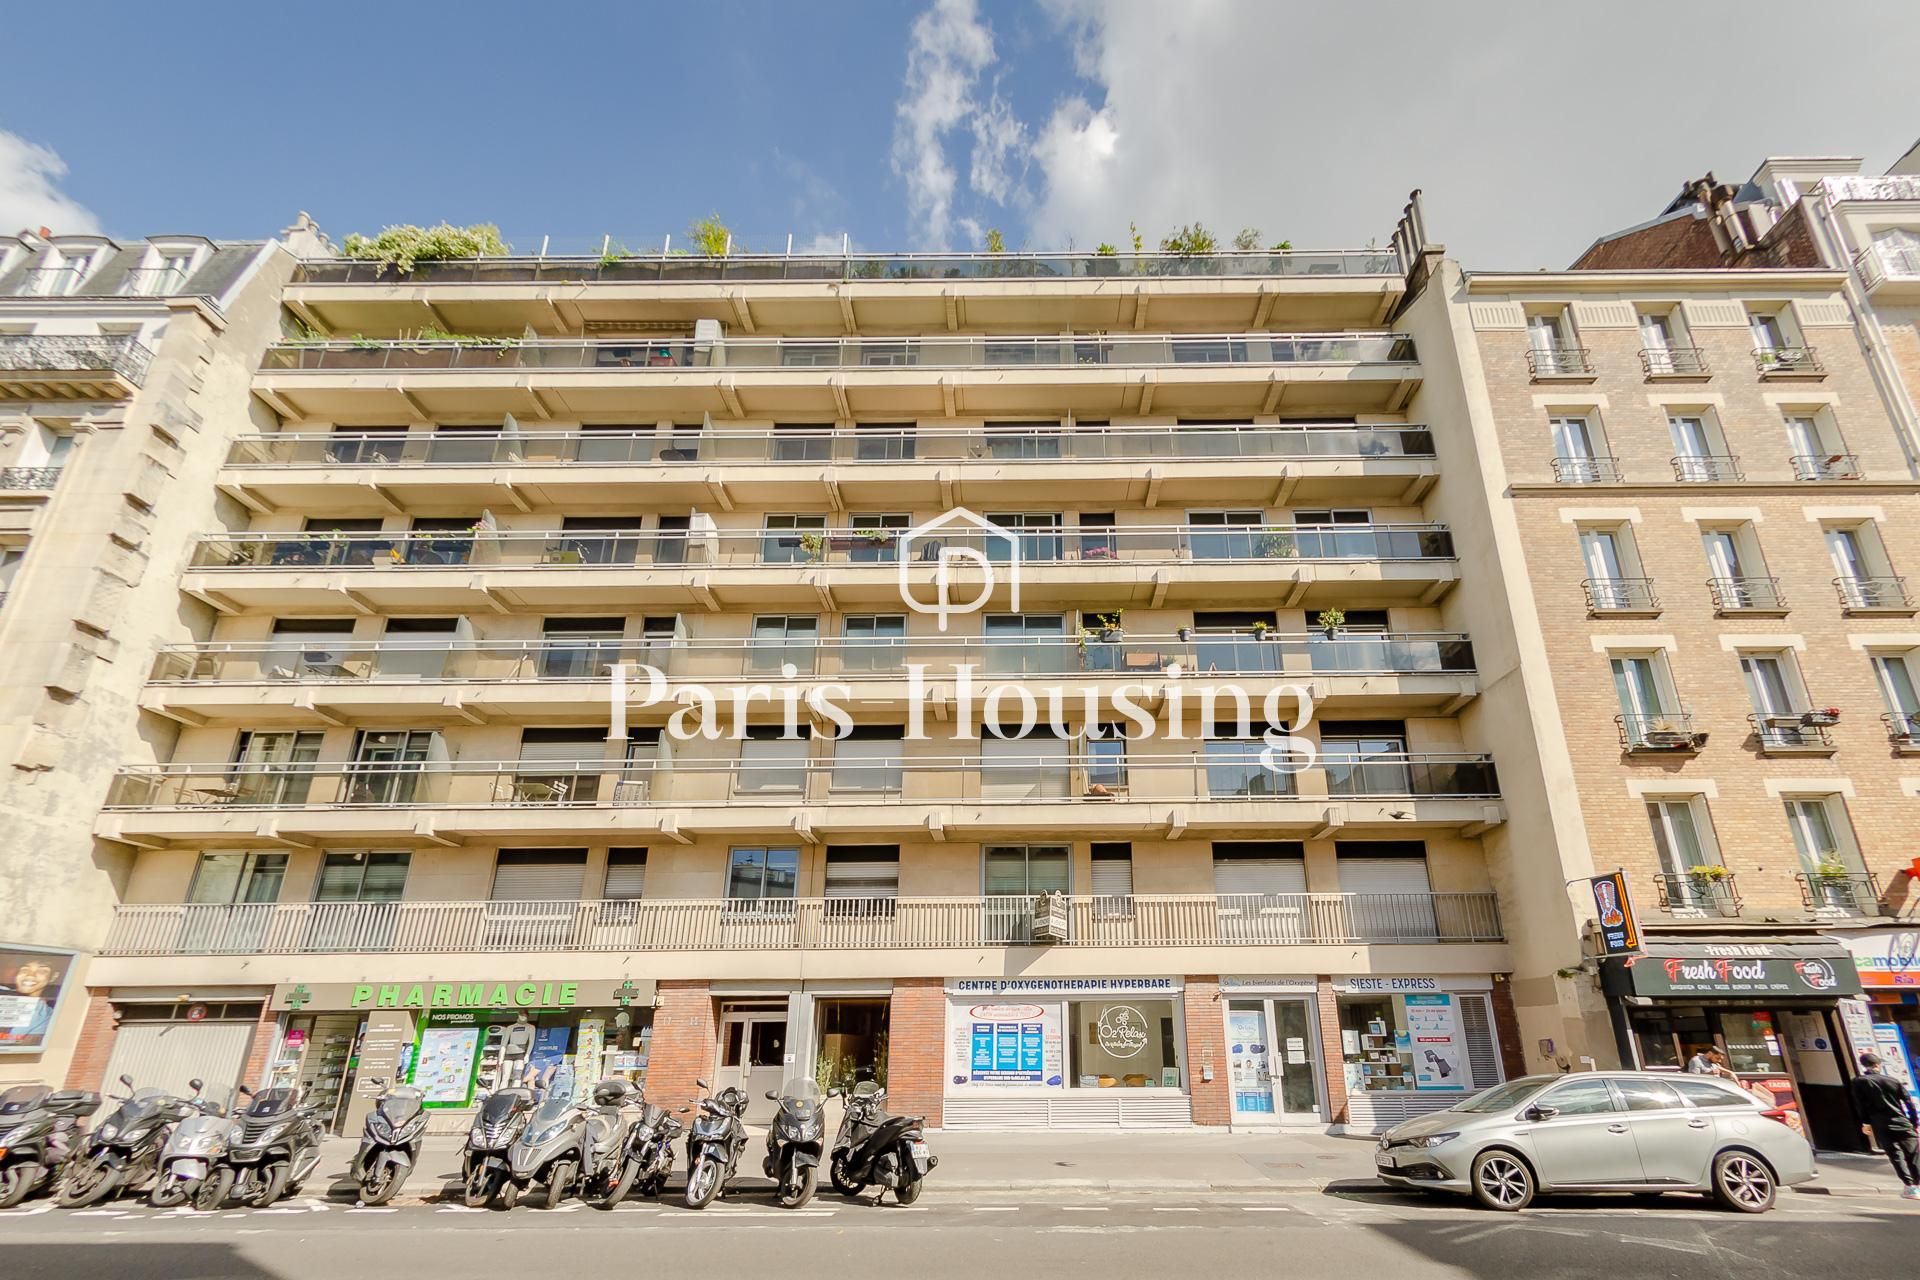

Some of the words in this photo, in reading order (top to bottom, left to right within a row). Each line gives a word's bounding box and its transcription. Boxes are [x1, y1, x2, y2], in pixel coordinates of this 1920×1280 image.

[1664, 958, 1717, 983] Fresh
[1714, 958, 1766, 983] Food
[958, 980, 997, 990] CENTRE
[1001, 979, 1107, 990] D'OXYGENOTHERAPIE
[1111, 978, 1171, 989] HYPERBARE
[1350, 978, 1382, 989] SIESTE
[1392, 978, 1436, 989] EXPRESS
[351, 983, 578, 1008] PHARMACIE
